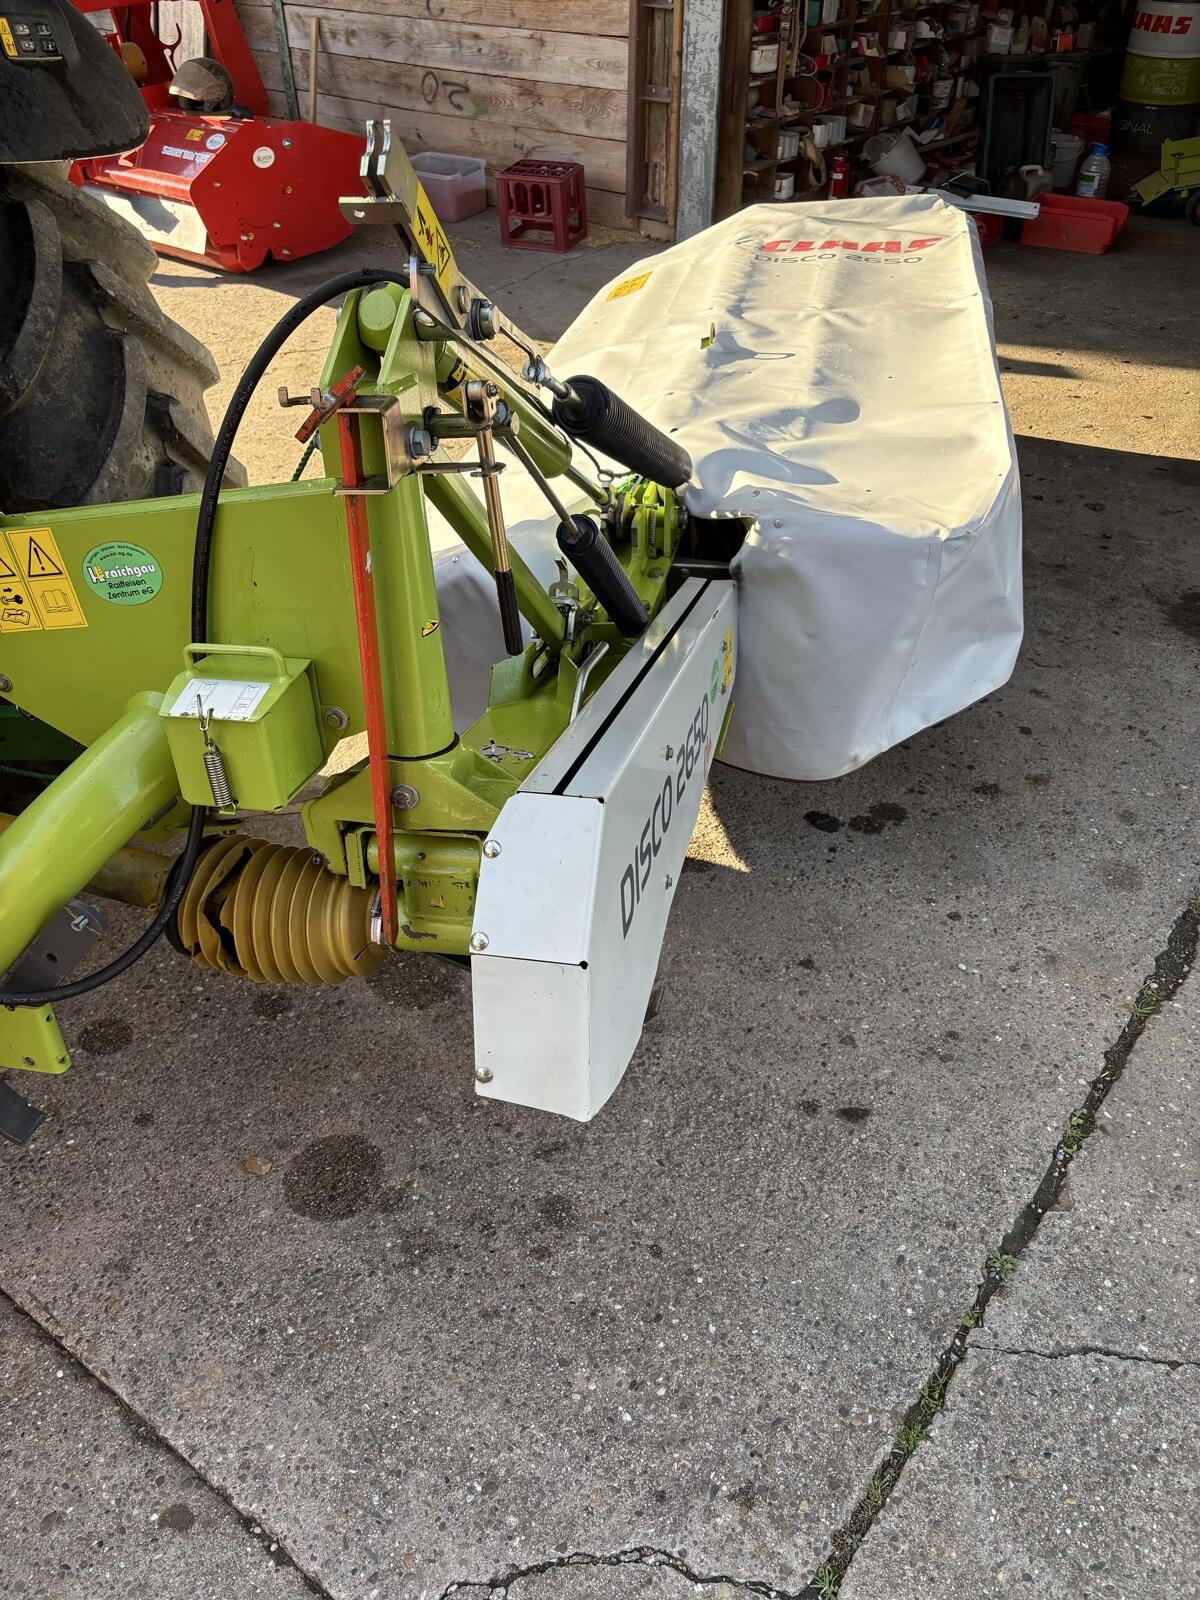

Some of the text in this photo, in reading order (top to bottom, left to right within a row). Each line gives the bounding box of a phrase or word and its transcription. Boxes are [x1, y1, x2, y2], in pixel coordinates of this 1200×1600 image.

[761, 235, 945, 254] CLAAS
[753, 253, 923, 265] DISCO 2650
[108, 579, 147, 590] Raiffeisen
[107, 586, 155, 600] Zentrum eG
[620, 692, 710, 941] DISCO 2650
